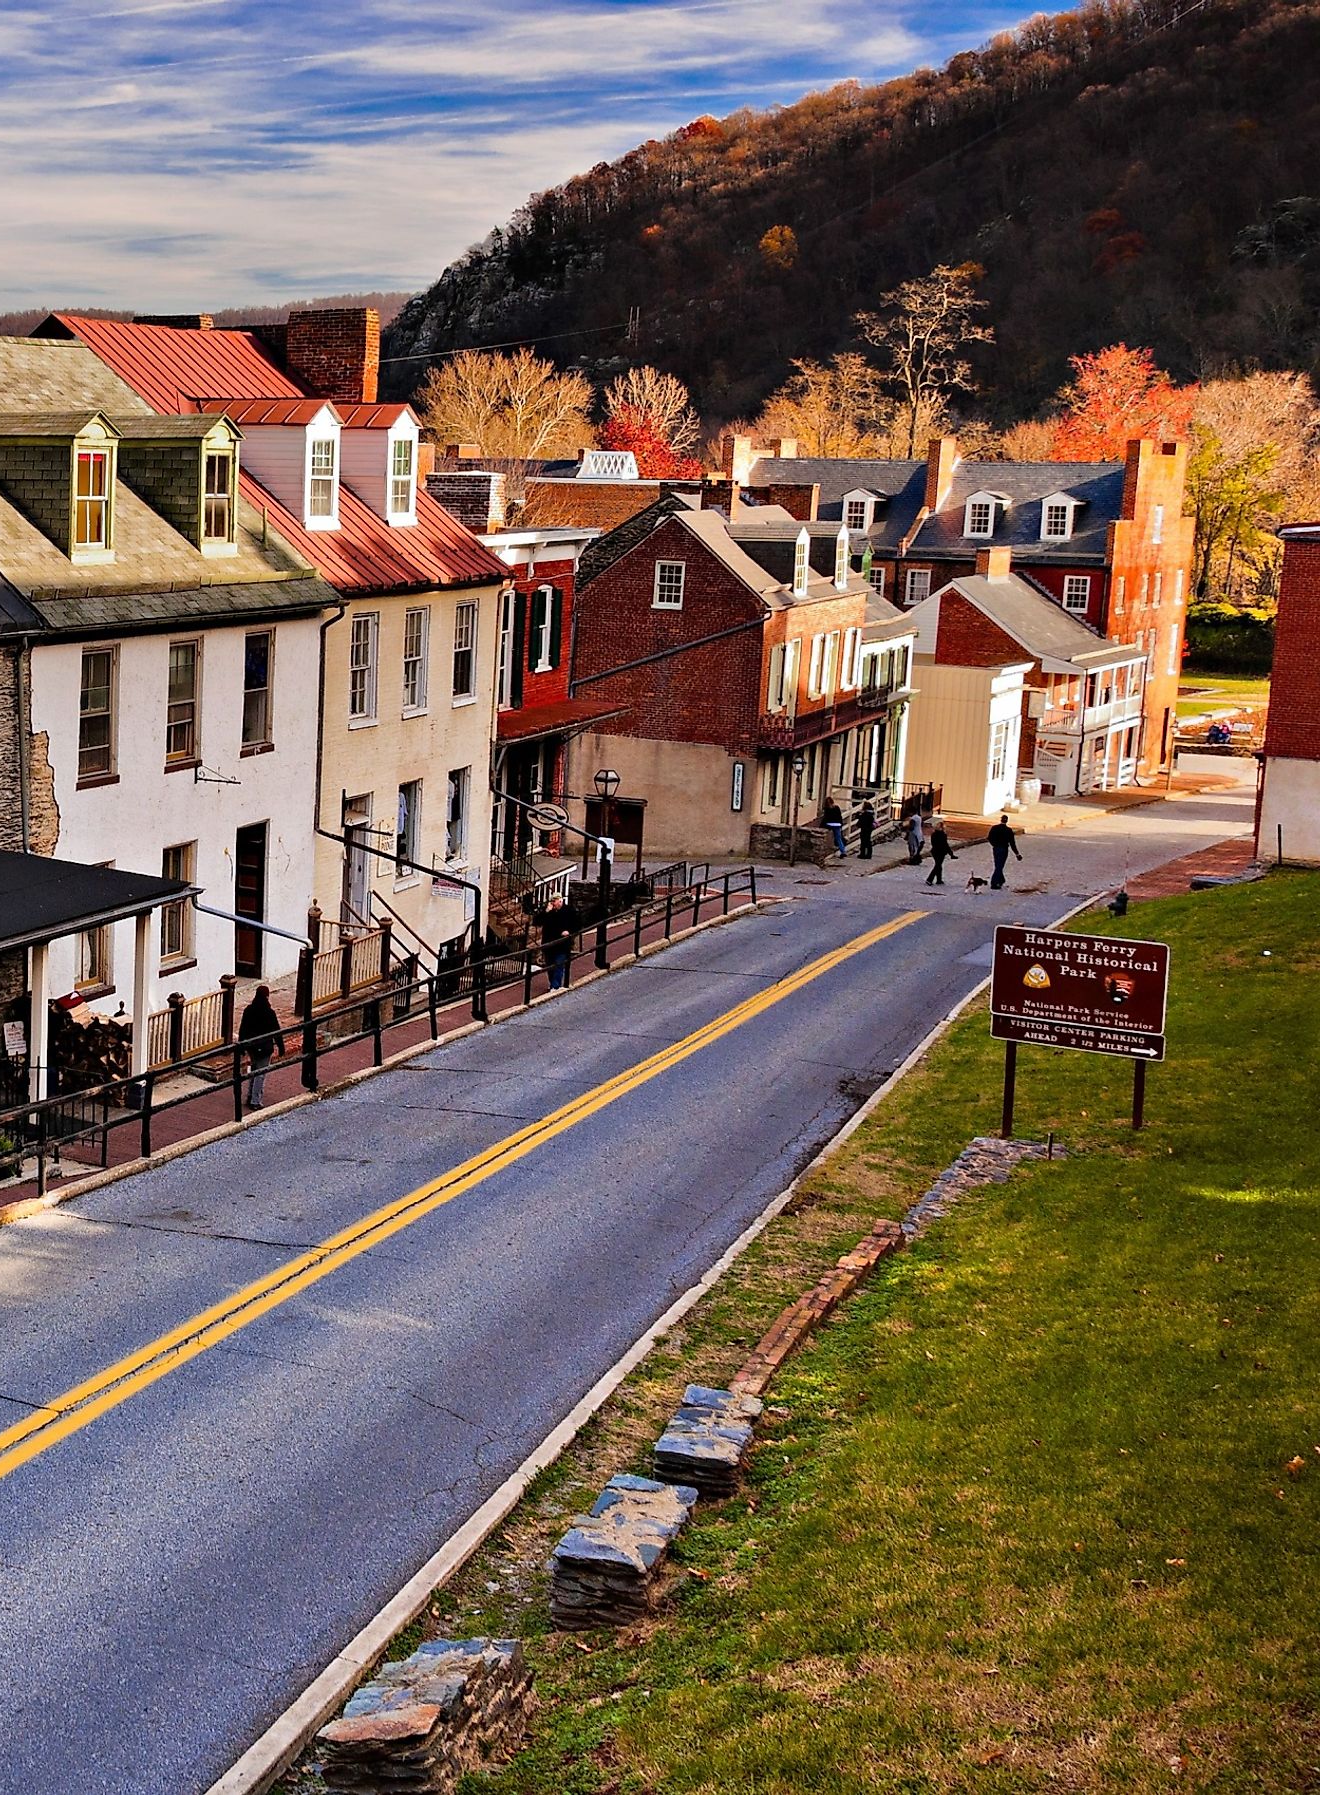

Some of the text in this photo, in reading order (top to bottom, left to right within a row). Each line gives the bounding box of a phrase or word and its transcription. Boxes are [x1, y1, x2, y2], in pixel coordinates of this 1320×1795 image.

[1025, 933, 1137, 957] Harpers Ferry
[1003, 944, 1158, 972] National Historical
[1060, 965, 1097, 979] Park
[1000, 1004, 1018, 1012] U.S.
[1022, 1007, 1077, 1020] Department
[1114, 1019, 1154, 1030] Interior
[1024, 1000, 1129, 1019] National Park Service
[1011, 1020, 1145, 1044] VISITOR CENTER PARKING
[1024, 1032, 1058, 1042] AHEAD
[1081, 1040, 1093, 1048] 1/2
[1097, 1042, 1130, 1052] MILES
